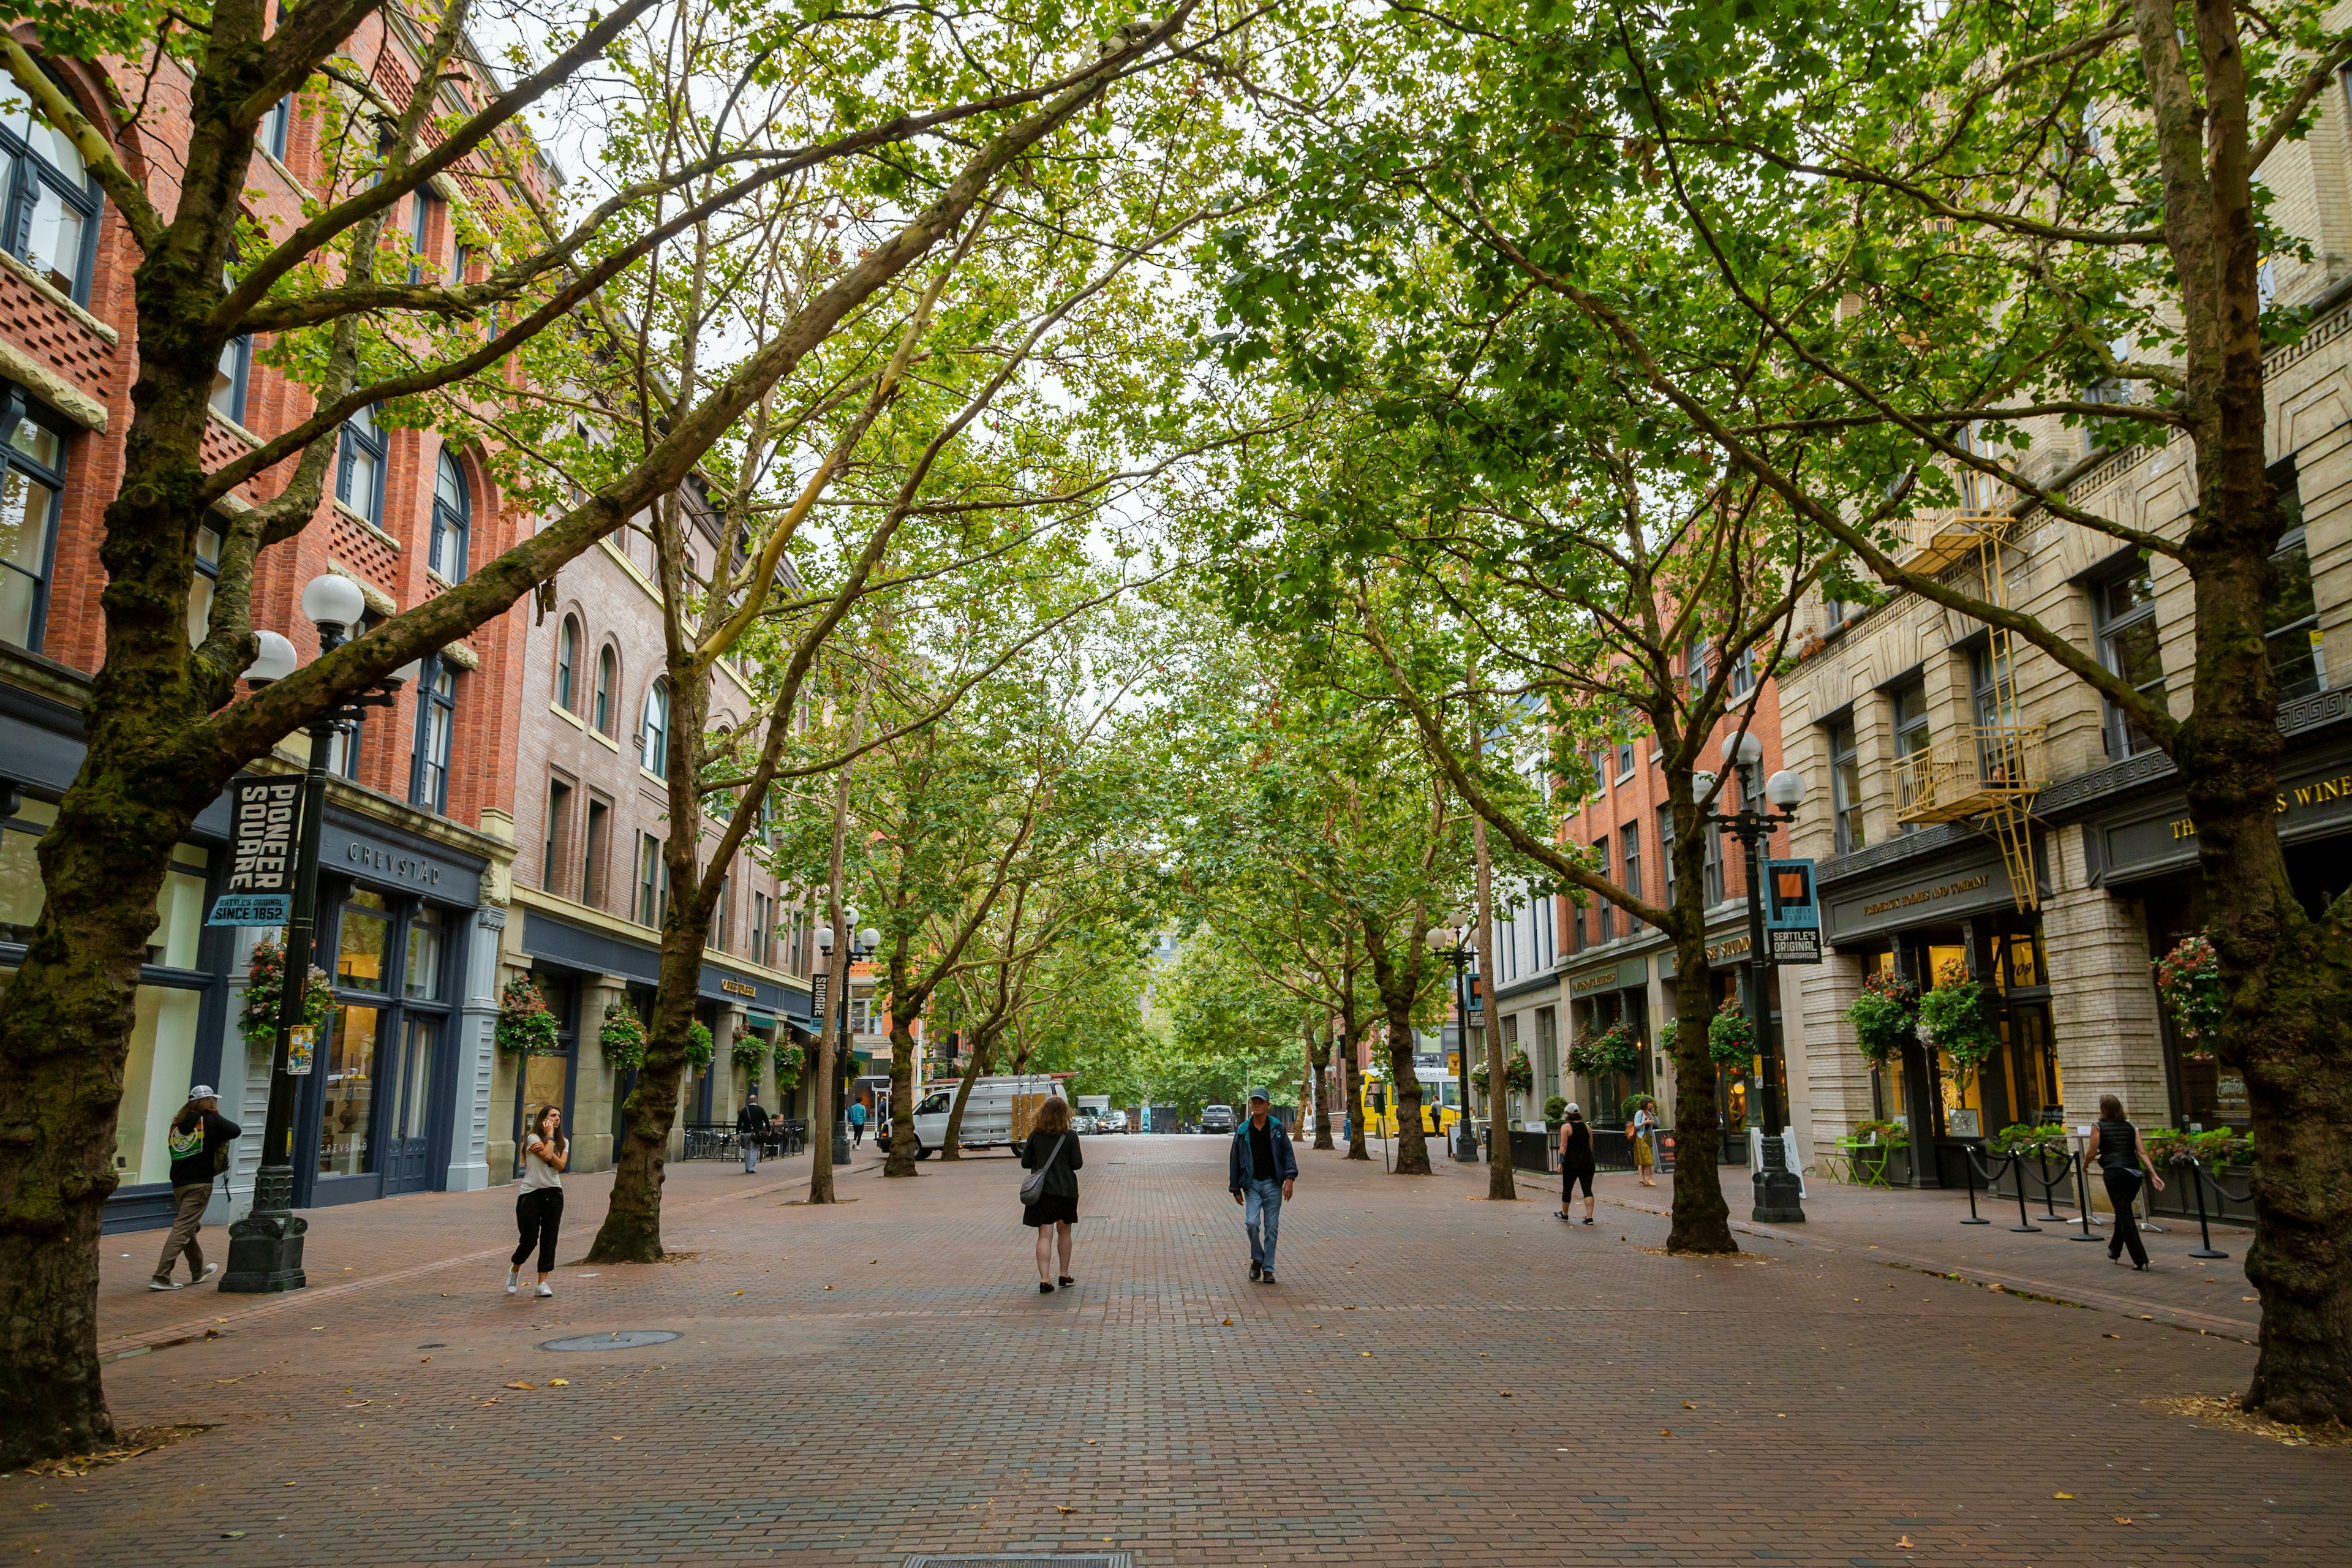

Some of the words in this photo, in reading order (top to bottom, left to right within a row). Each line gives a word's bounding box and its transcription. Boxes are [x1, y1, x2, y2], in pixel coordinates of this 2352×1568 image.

[229, 786, 268, 889] SQUARE
[254, 784, 296, 888] PIONEER
[2169, 818, 2198, 839] TH
[1932, 885, 1948, 900] AND
[1950, 875, 1989, 894] COMPANY
[215, 908, 250, 920] SINCE
[253, 908, 282, 920] 1852
[1773, 932, 1816, 941] SEATTLE'S
[1774, 941, 1817, 952] ORIGINAL
[814, 977, 827, 1016] SQUARE
